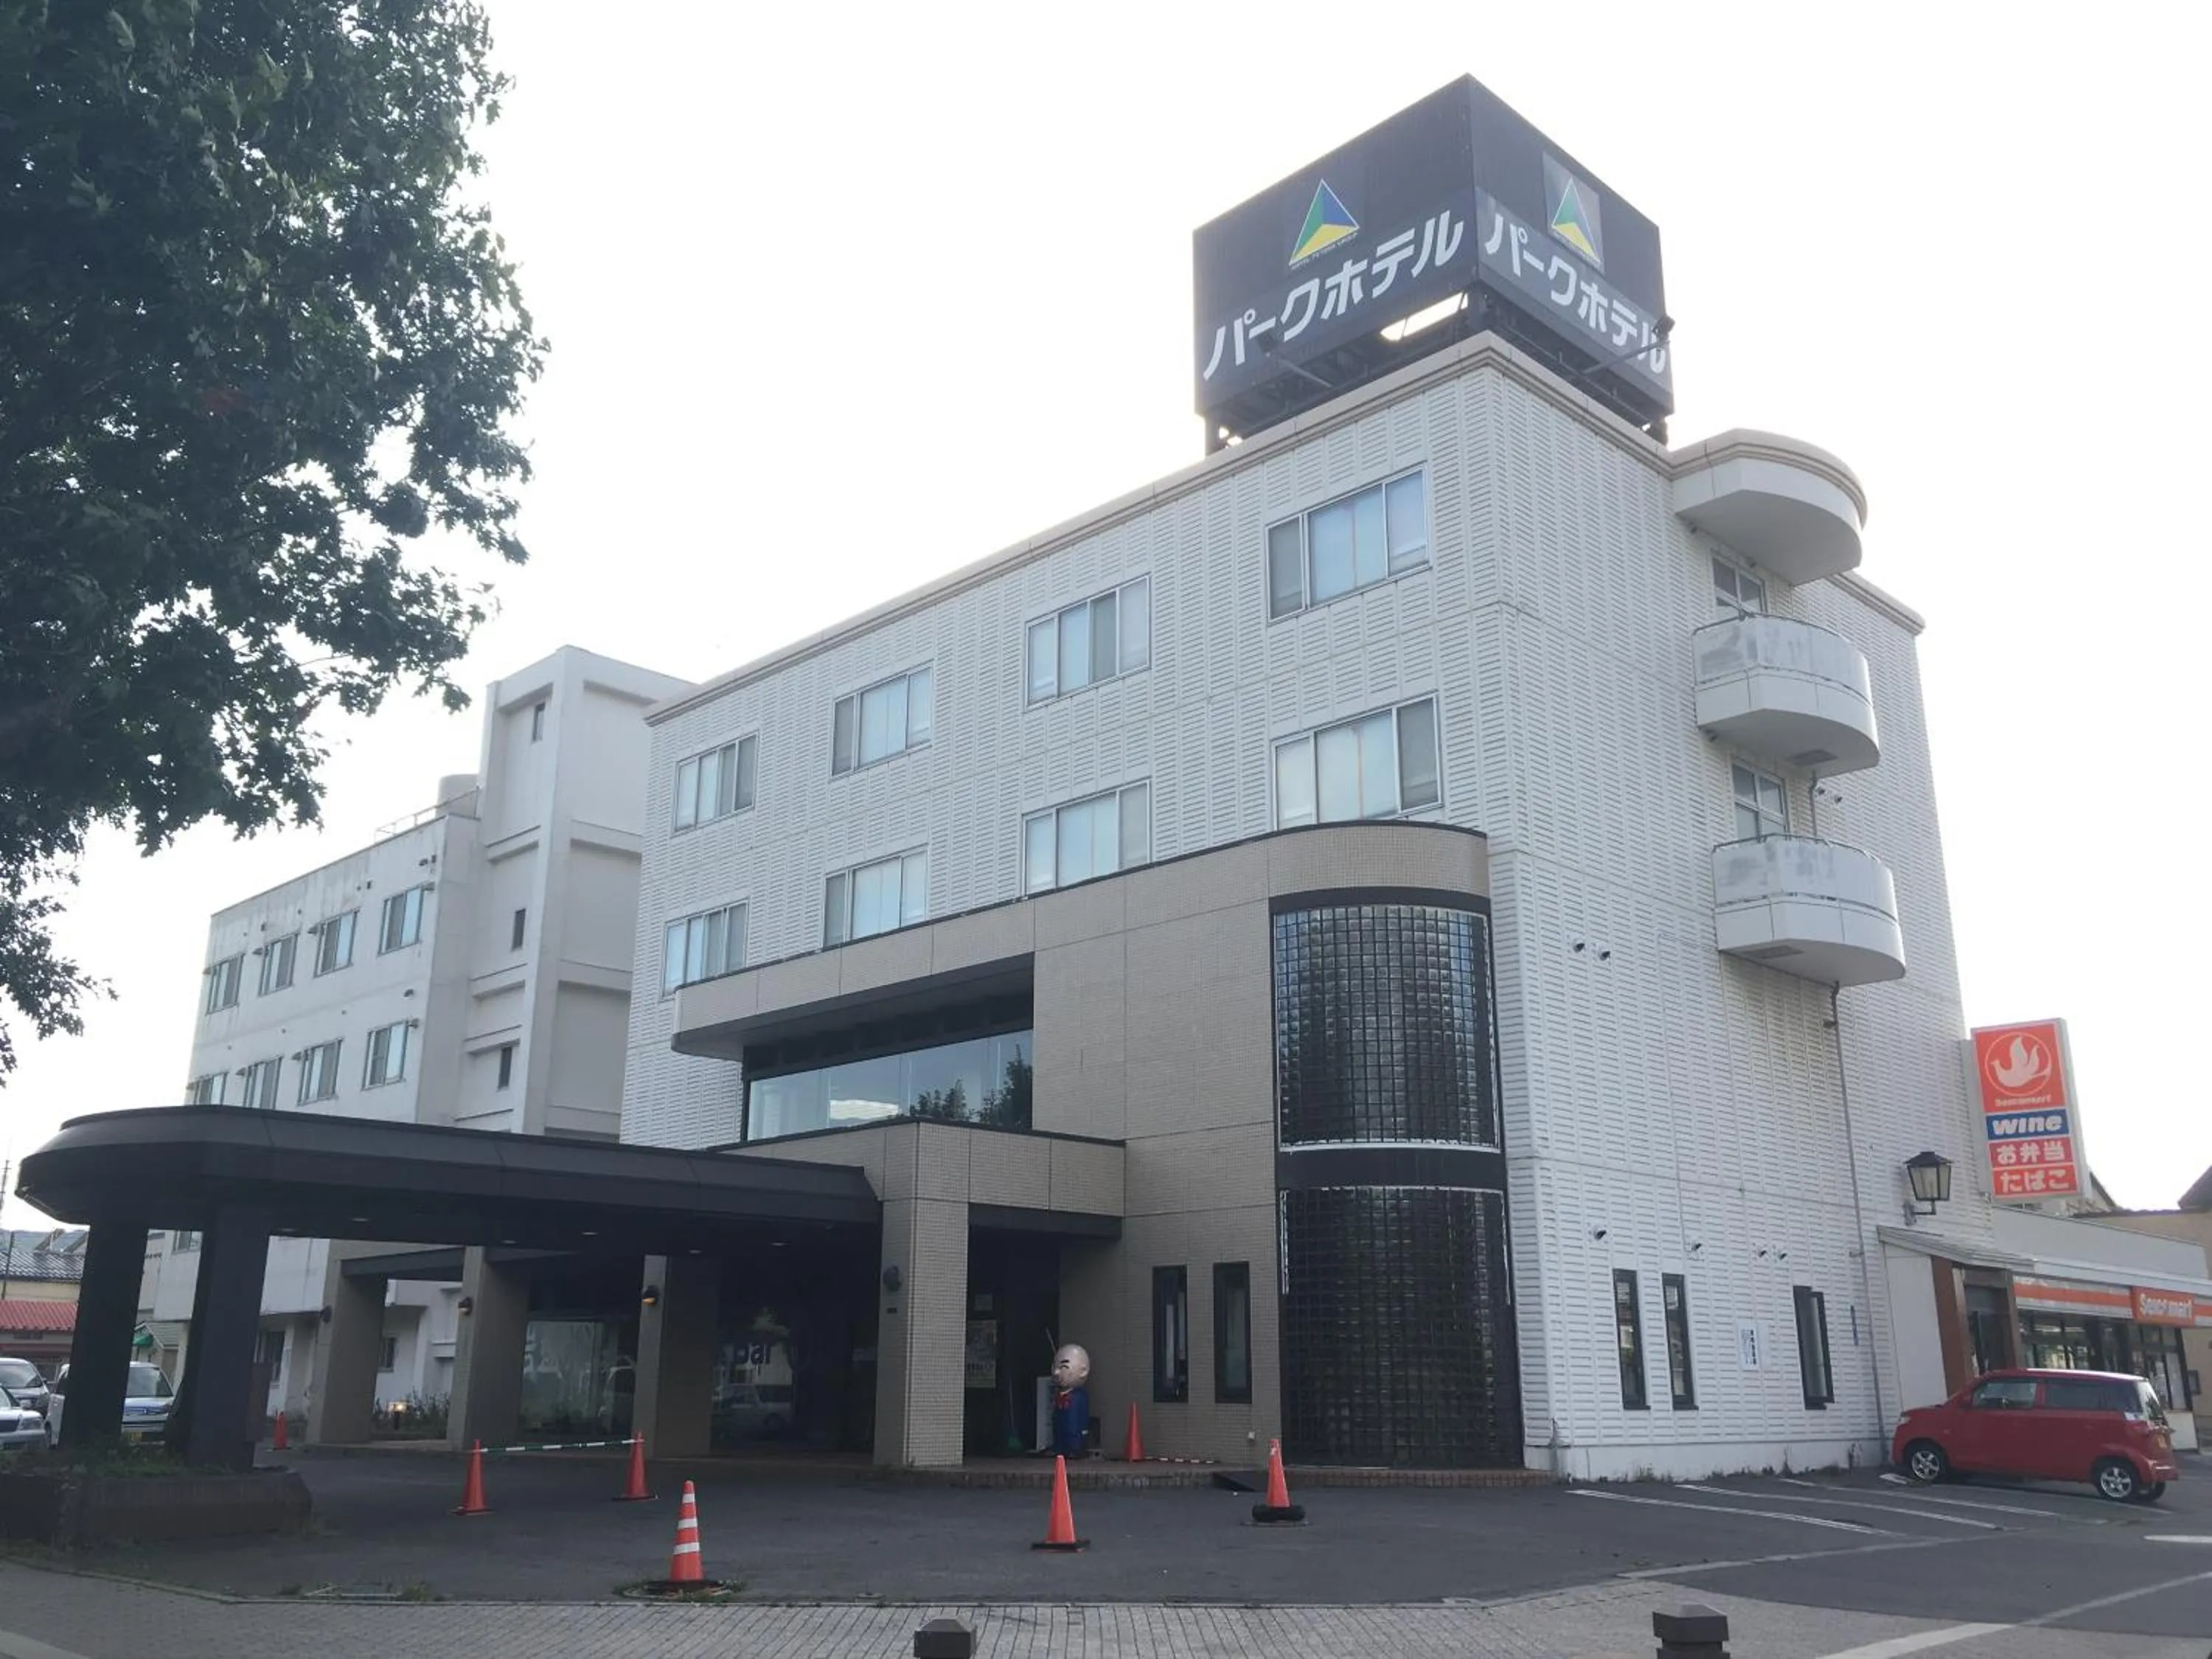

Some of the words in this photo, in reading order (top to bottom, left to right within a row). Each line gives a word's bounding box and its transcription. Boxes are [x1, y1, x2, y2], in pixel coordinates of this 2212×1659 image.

[1203, 210, 1464, 380] パークホテル
[1484, 213, 1666, 373] パークホテル
[1992, 1116, 2062, 1135] wine
[1996, 1141, 2065, 1164] お弁当
[2000, 1169, 2069, 1194] たばこ
